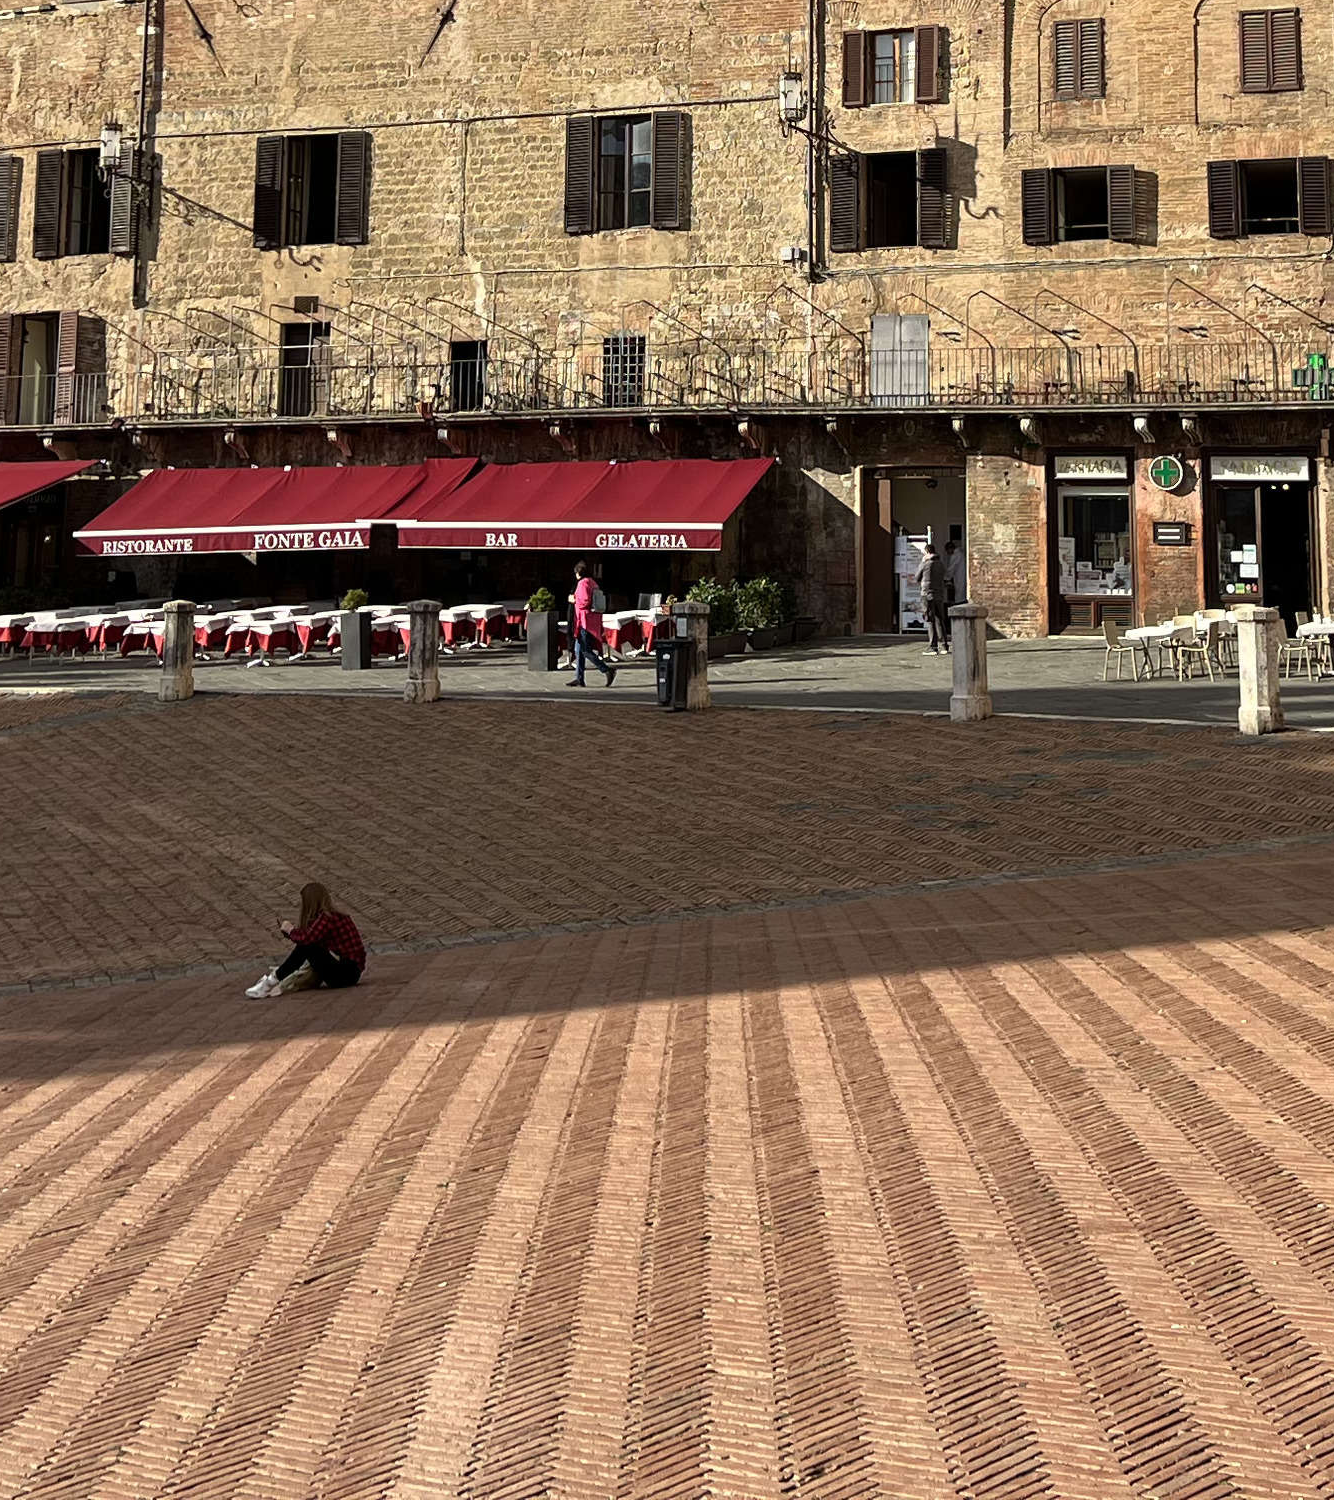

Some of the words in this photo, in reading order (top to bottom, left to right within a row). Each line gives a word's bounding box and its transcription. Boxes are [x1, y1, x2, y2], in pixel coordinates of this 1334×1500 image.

[102, 538, 193, 554] RISTORANTE
[253, 532, 315, 550] FONTE
[318, 530, 365, 548] GAIA
[485, 533, 518, 548] BAR
[595, 534, 688, 549] GELATERIA
